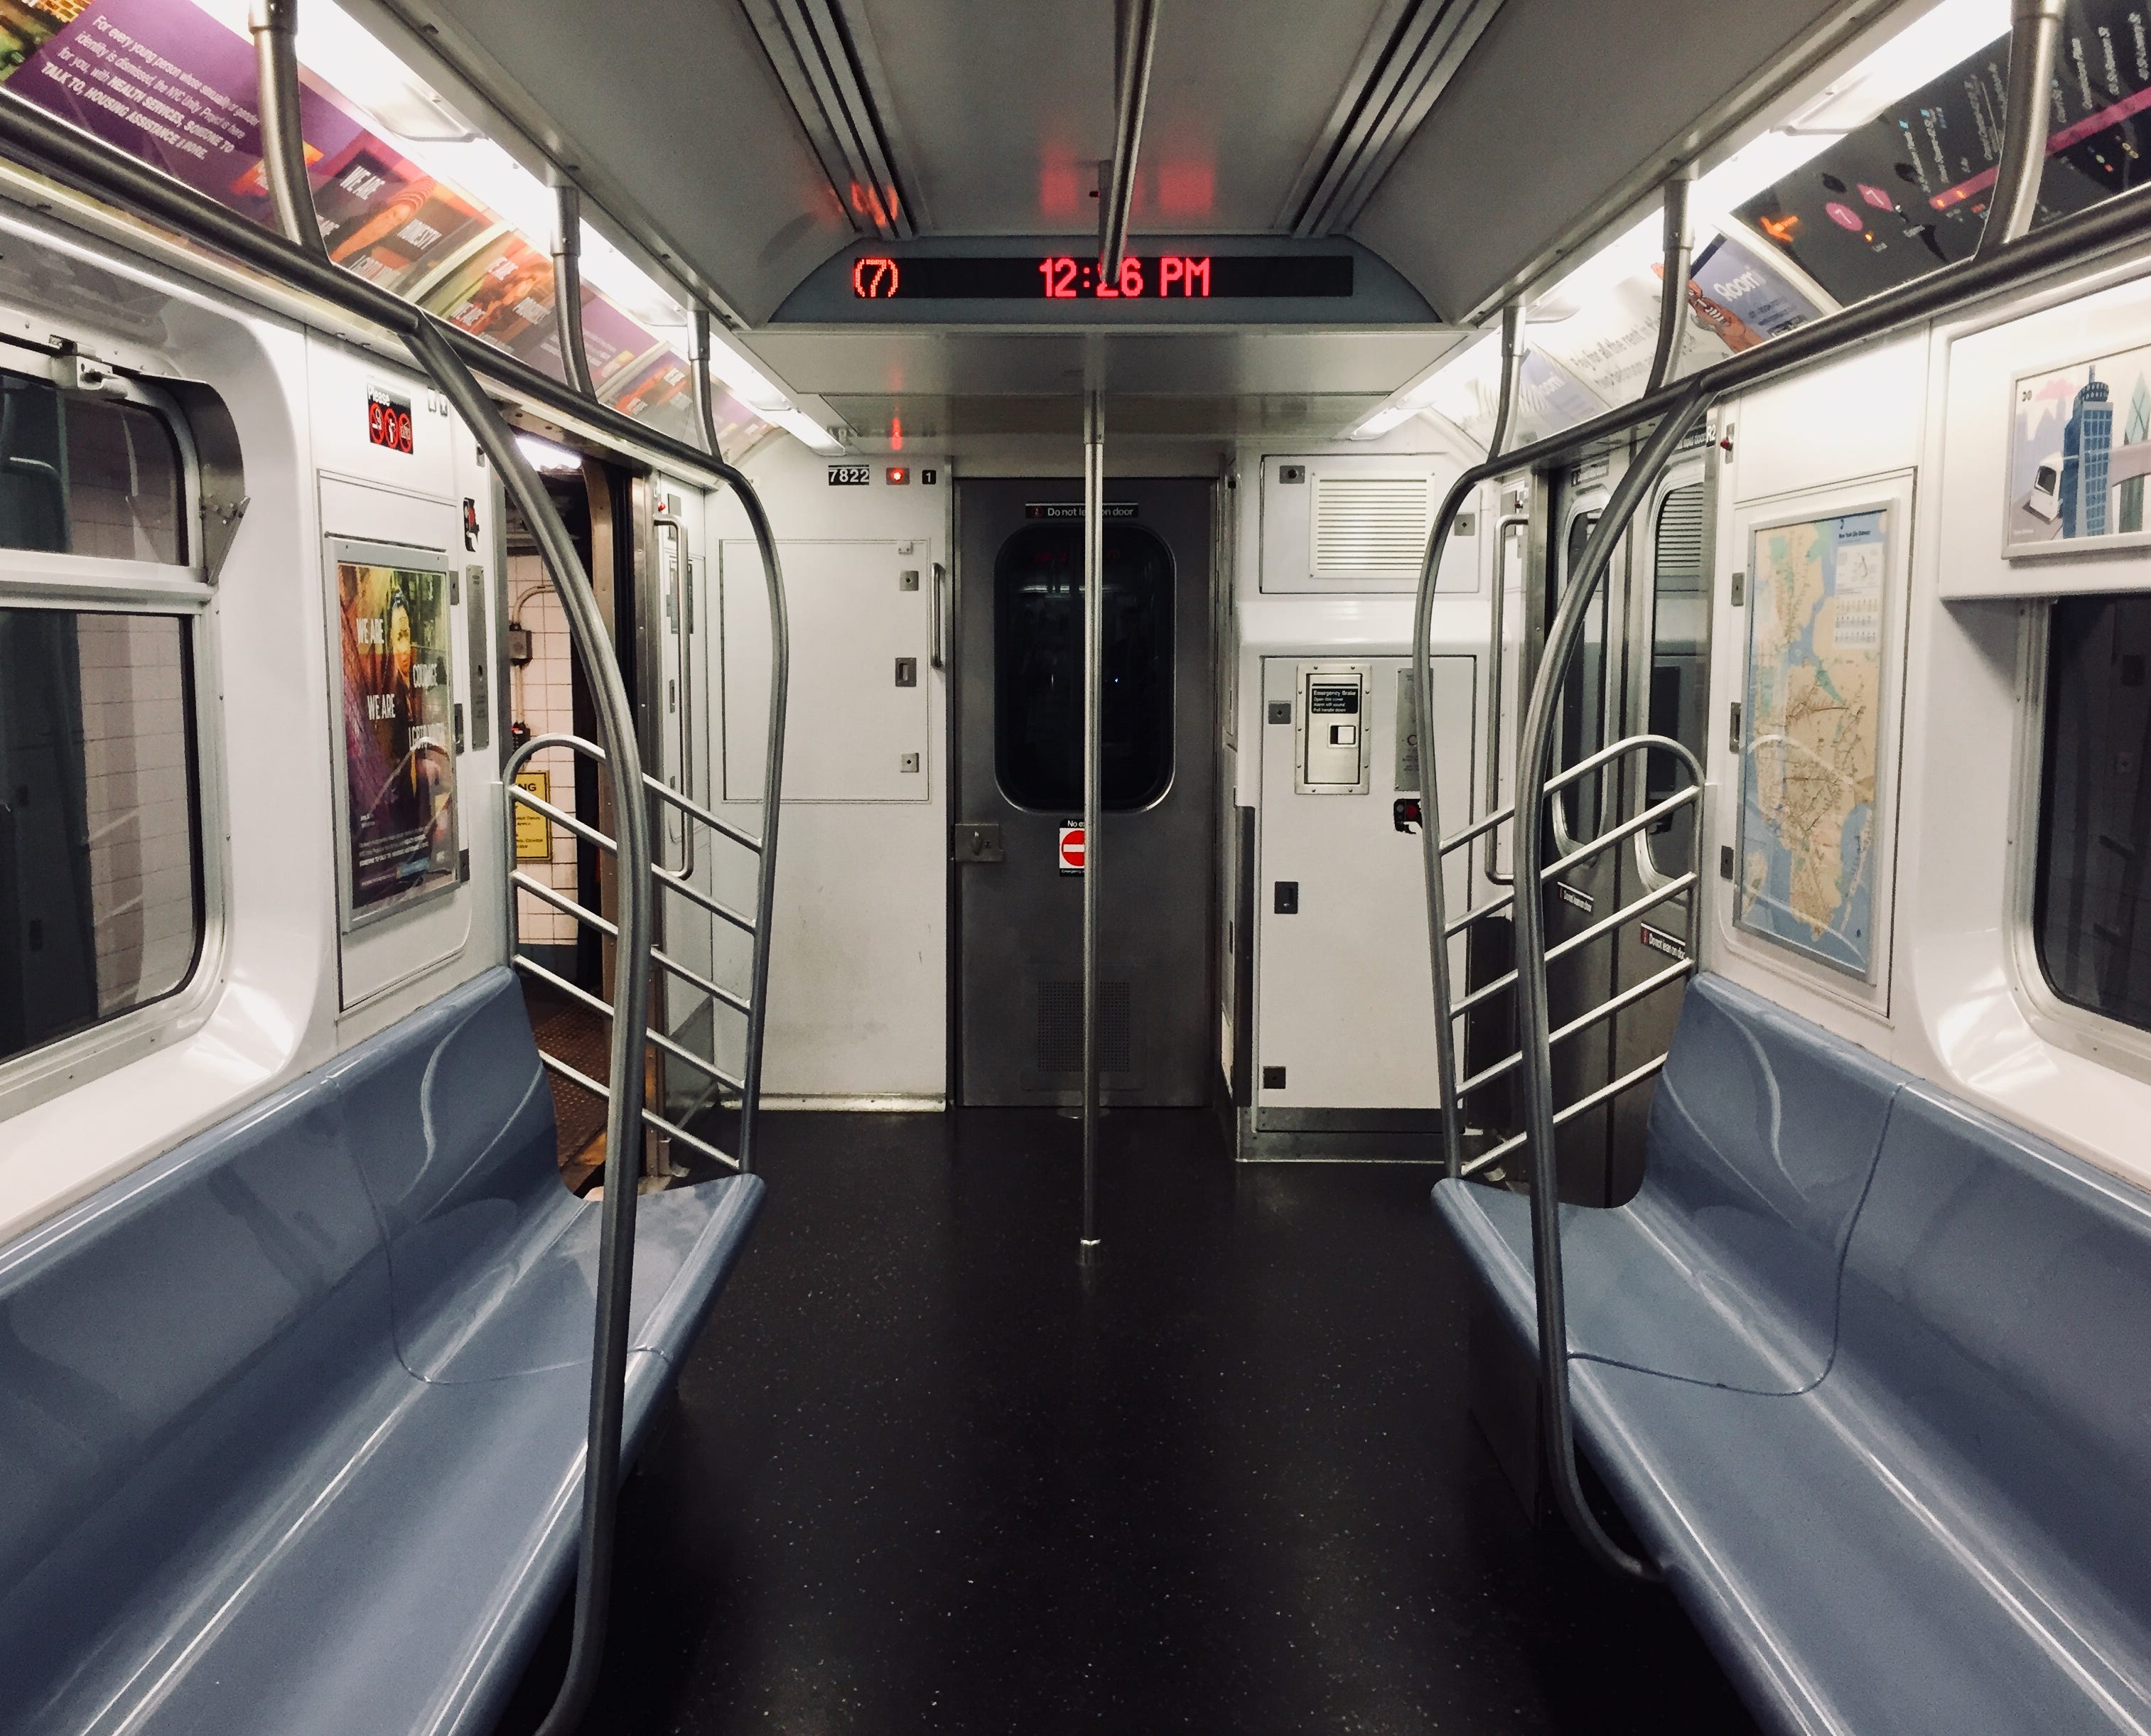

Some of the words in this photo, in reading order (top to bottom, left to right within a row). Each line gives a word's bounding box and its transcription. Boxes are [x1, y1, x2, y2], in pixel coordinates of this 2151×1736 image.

[92, 15, 112, 31] For
[109, 28, 134, 48] every
[129, 43, 157, 64] young
[151, 58, 181, 77] person
[179, 72, 203, 90] whose
[75, 31, 109, 57] identity
[105, 50, 117, 63] is
[153, 80, 168, 93] the
[165, 86, 185, 102] NYC
[181, 95, 203, 113] Unity
[41, 61, 72, 84] TALK
[68, 77, 86, 95] TO,
[84, 87, 130, 117] HOUSING
[125, 111, 180, 145] ASSISTANCE
[57, 46, 75, 61] for
[68, 57, 91, 74] you,
[90, 68, 110, 82] with
[107, 75, 147, 103] HEALTH
[142, 97, 185, 127] SERVICES,
[219, 140, 235, 153] TO
[340, 166, 371, 193] WE
[352, 176, 385, 200] ARE
[1835, 208, 1853, 225] 7
[1160, 257, 1209, 297] PM
[368, 386, 390, 406] Please
[829, 469, 870, 482] 7822
[926, 473, 932, 482] 1
[1047, 507, 1061, 517] Do
[1062, 508, 1077, 517] not
[1113, 507, 1134, 517] door
[357, 618, 369, 644] WE
[370, 618, 384, 644] ARE
[367, 694, 380, 721] WE
[381, 694, 396, 719] ARE
